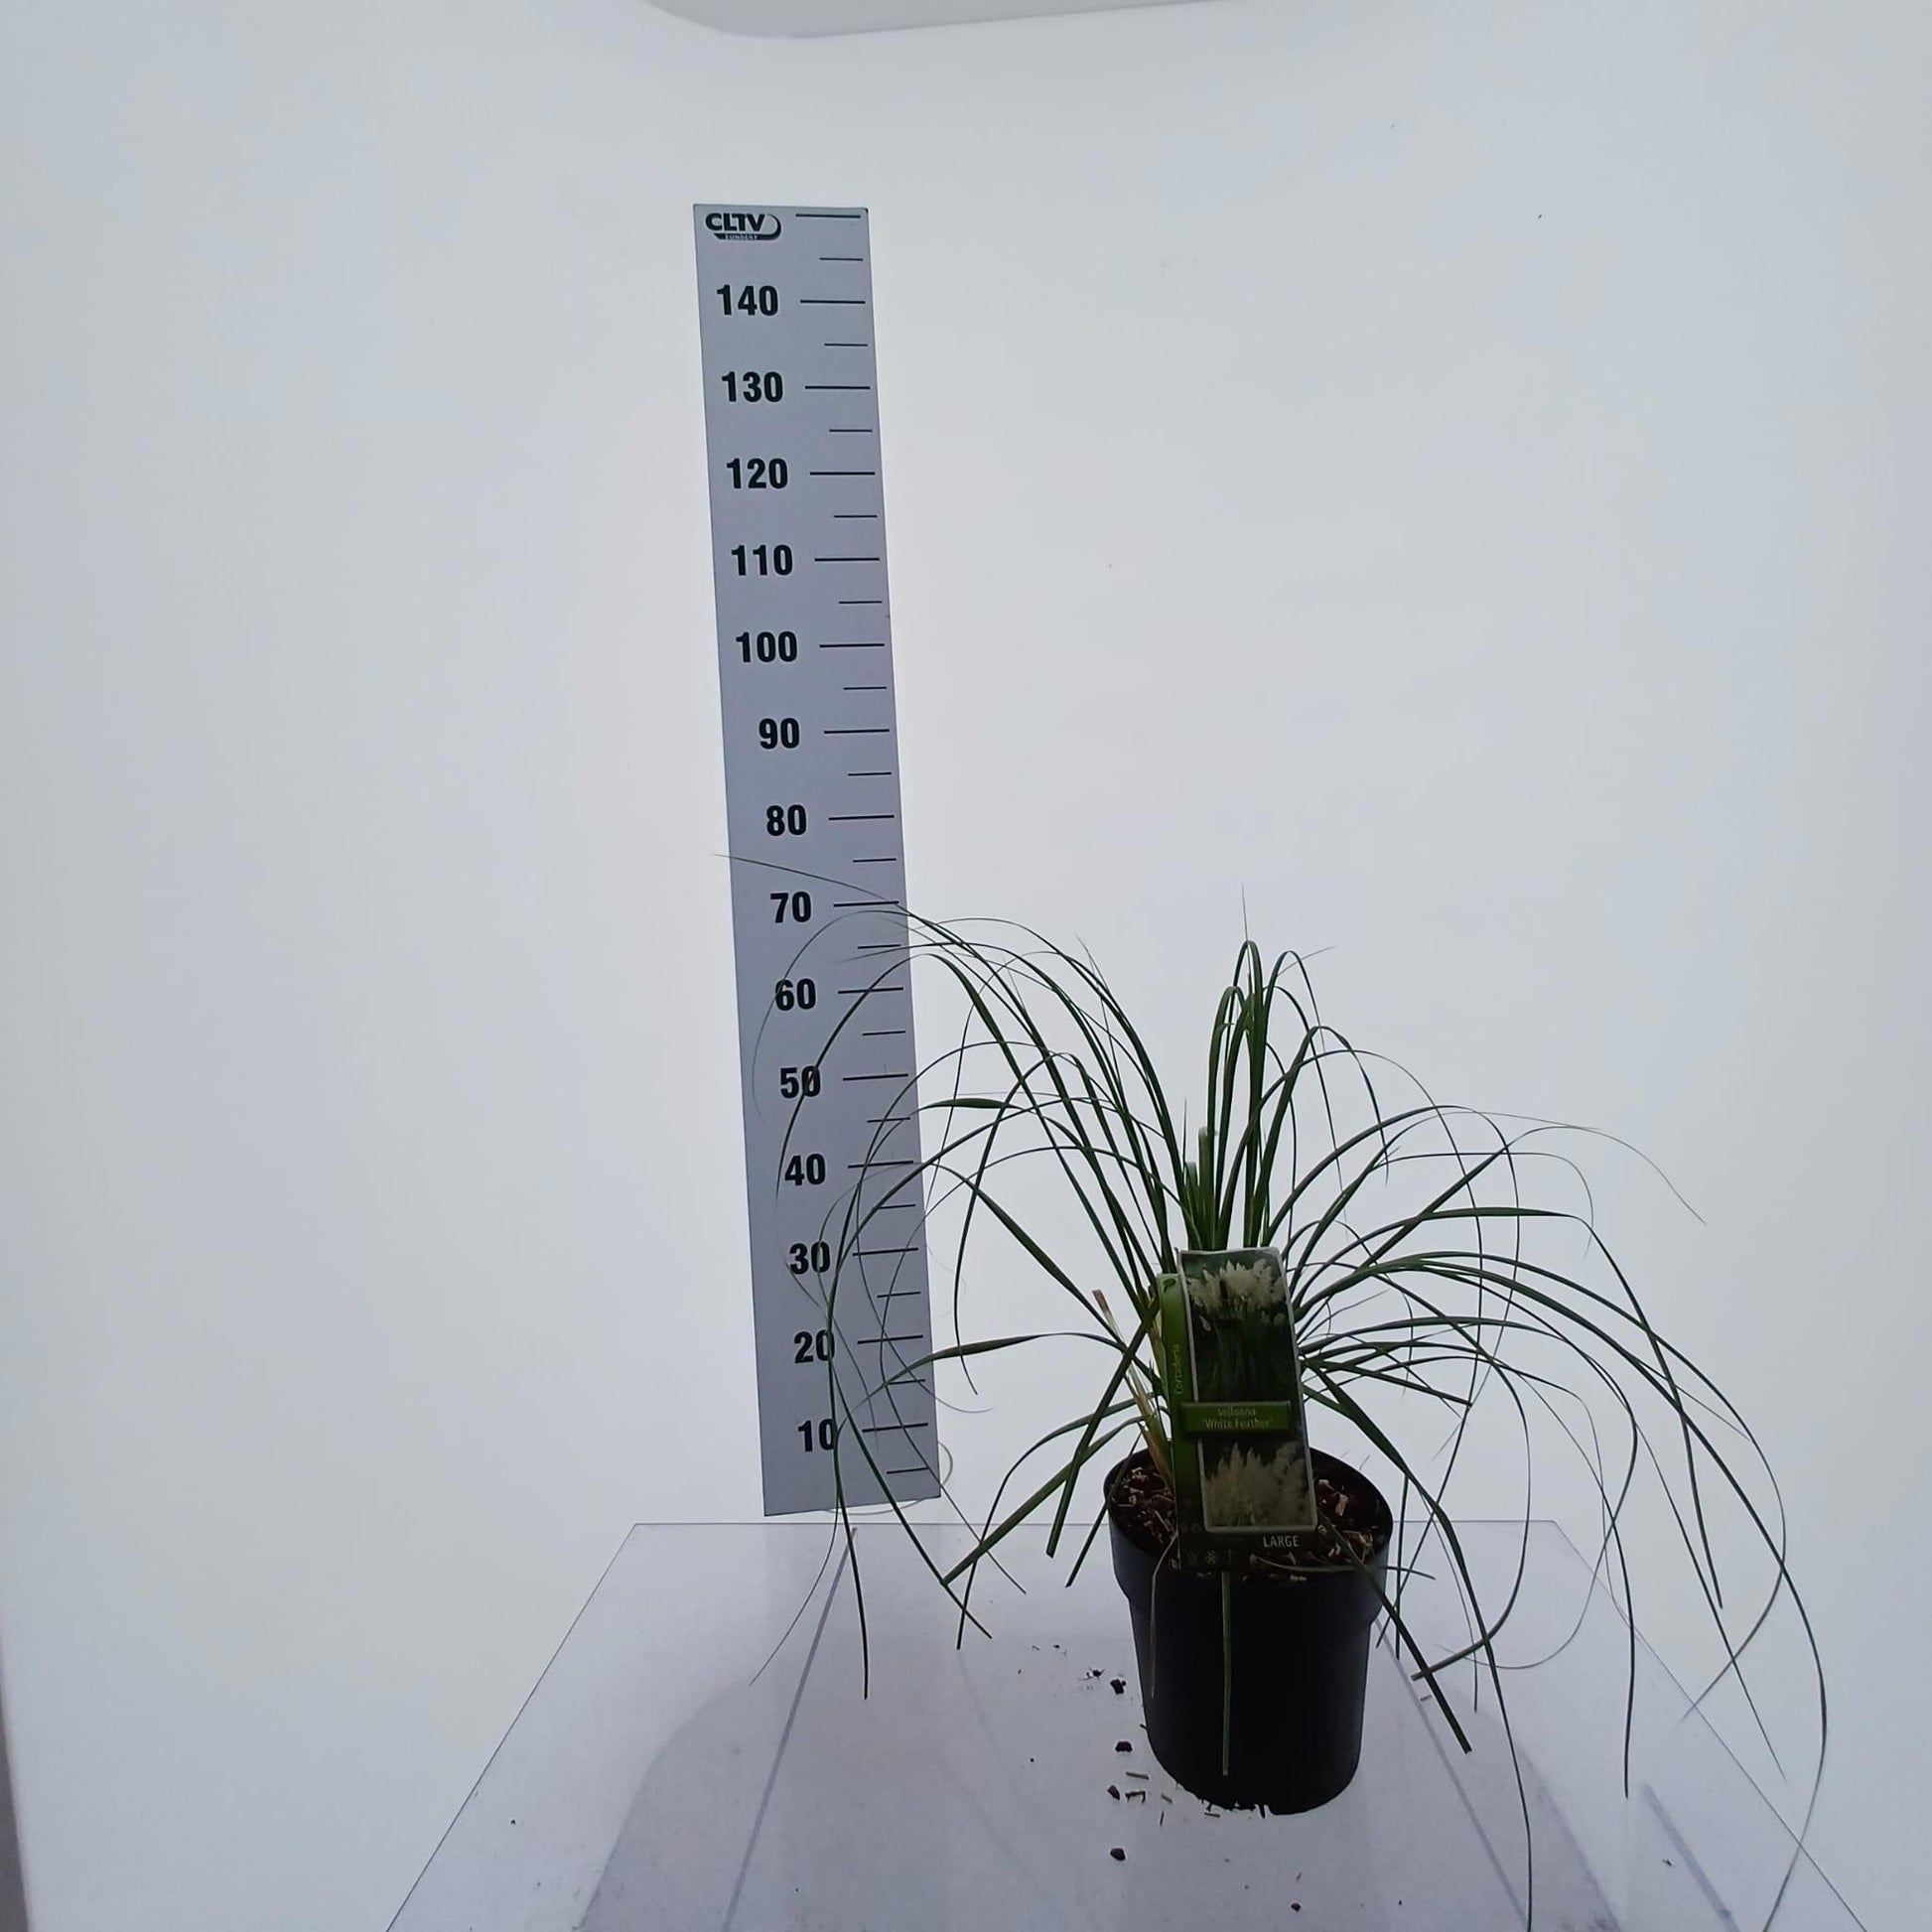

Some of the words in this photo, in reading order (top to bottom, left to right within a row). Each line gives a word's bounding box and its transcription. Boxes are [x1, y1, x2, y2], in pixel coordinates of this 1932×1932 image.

[705, 212, 765, 231] CLTV
[717, 285, 778, 316] 140
[722, 371, 783, 402] 130
[727, 458, 788, 488] 120
[732, 545, 793, 576] 110
[736, 631, 798, 662] 100
[759, 718, 800, 750] 90
[765, 804, 807, 836] 80
[770, 892, 812, 923] 70
[774, 978, 816, 1011] 60
[780, 1065, 821, 1099] 50
[784, 1154, 826, 1186] 40
[789, 1241, 831, 1275] 30
[794, 1329, 835, 1364] 20
[797, 1419, 836, 1452] 10
[1263, 1535, 1300, 1548] LARGE
